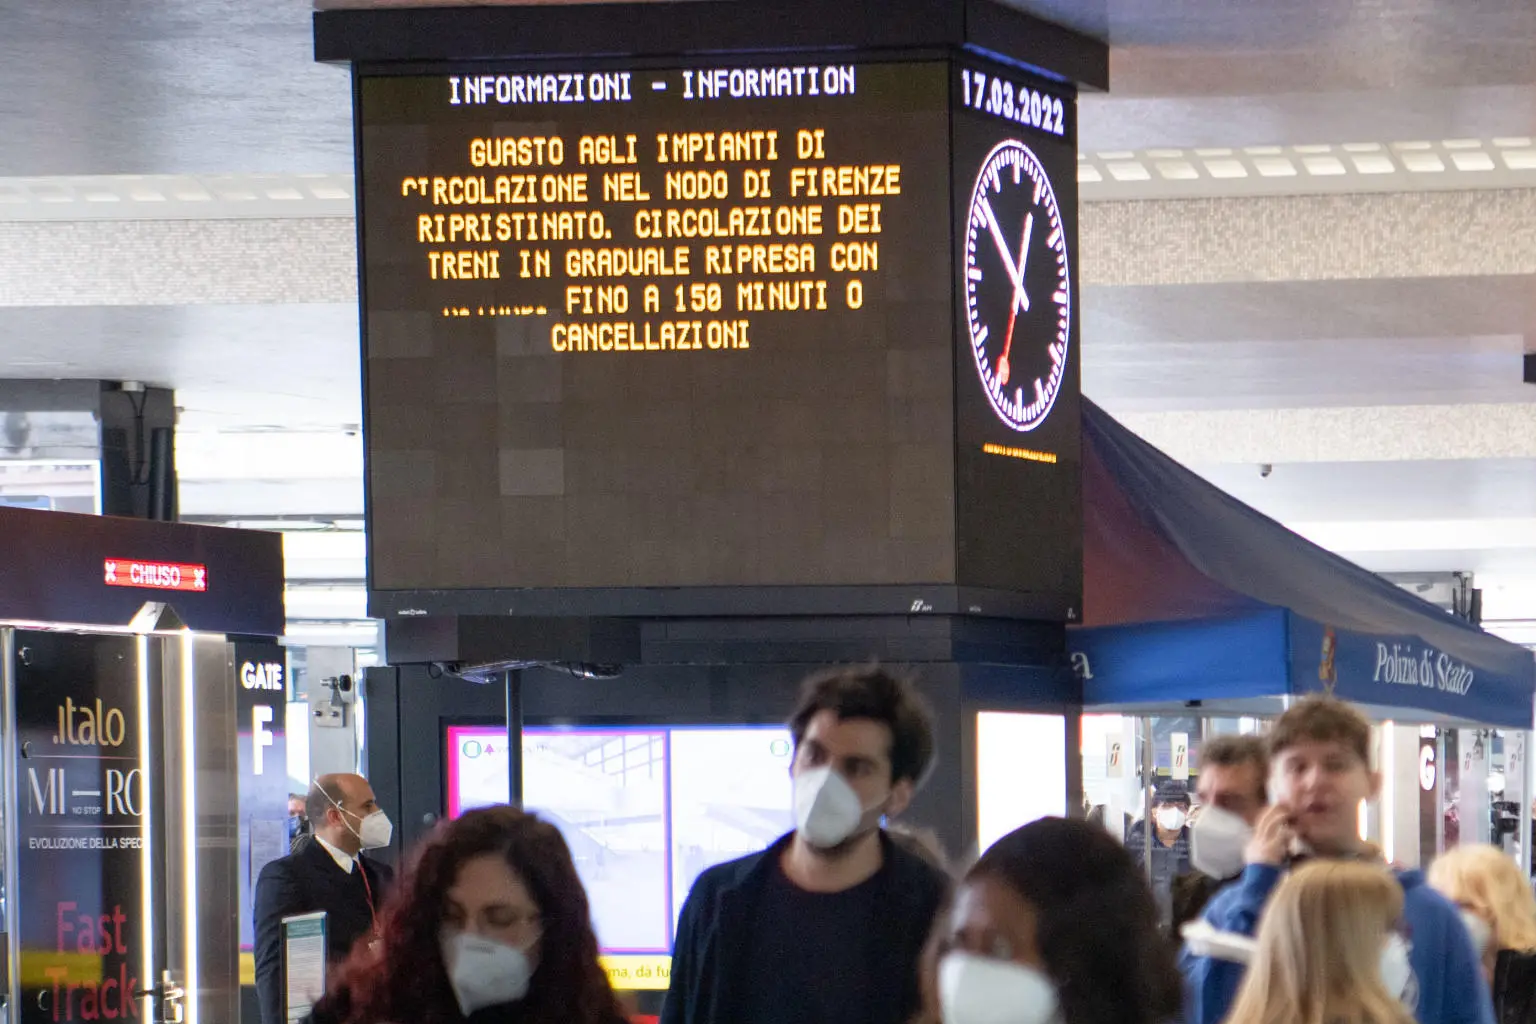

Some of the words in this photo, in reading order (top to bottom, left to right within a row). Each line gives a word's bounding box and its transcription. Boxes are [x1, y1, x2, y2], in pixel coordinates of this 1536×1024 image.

[449, 72, 632, 104] INFORMAZIONI
[682, 65, 855, 99] INFORMATION
[962, 69, 1064, 135] 17.03.2022
[470, 136, 564, 167] GUASTO
[579, 134, 638, 165] AGLI
[657, 131, 778, 163] IMPIANTI
[797, 129, 825, 160] DI
[603, 172, 651, 202] NEL
[665, 170, 729, 200] NODO
[743, 169, 772, 199] DI
[790, 165, 901, 197] FIRENZE
[418, 211, 612, 243] RIPRISTINATO.
[635, 205, 823, 239] CIRCOLAZIONE
[838, 203, 882, 234] DEI
[428, 250, 500, 280] TRENI
[519, 249, 551, 278] IN
[565, 246, 690, 278] GRADUALE
[705, 243, 815, 275] RIPRESA
[830, 241, 878, 272] CON
[566, 285, 629, 315] FINO
[643, 284, 660, 313] A
[675, 283, 722, 313] 150
[737, 280, 828, 312] MINUTI
[846, 279, 863, 310] O
[551, 319, 750, 352] CANCELLAZIONI
[130, 563, 181, 587] CHIUSO
[240, 661, 282, 690] GATE
[1373, 642, 1418, 686] Polizia
[1419, 649, 1435, 687] di
[1436, 653, 1474, 696] Stato
[252, 705, 273, 775] F
[1420, 745, 1436, 791] G
[84, 806, 101, 815] STOP
[29, 836, 88, 850] EVOLUZIONE
[89, 837, 118, 849] DELLA
[57, 901, 128, 956] Fast
[45, 962, 139, 1023] Track
